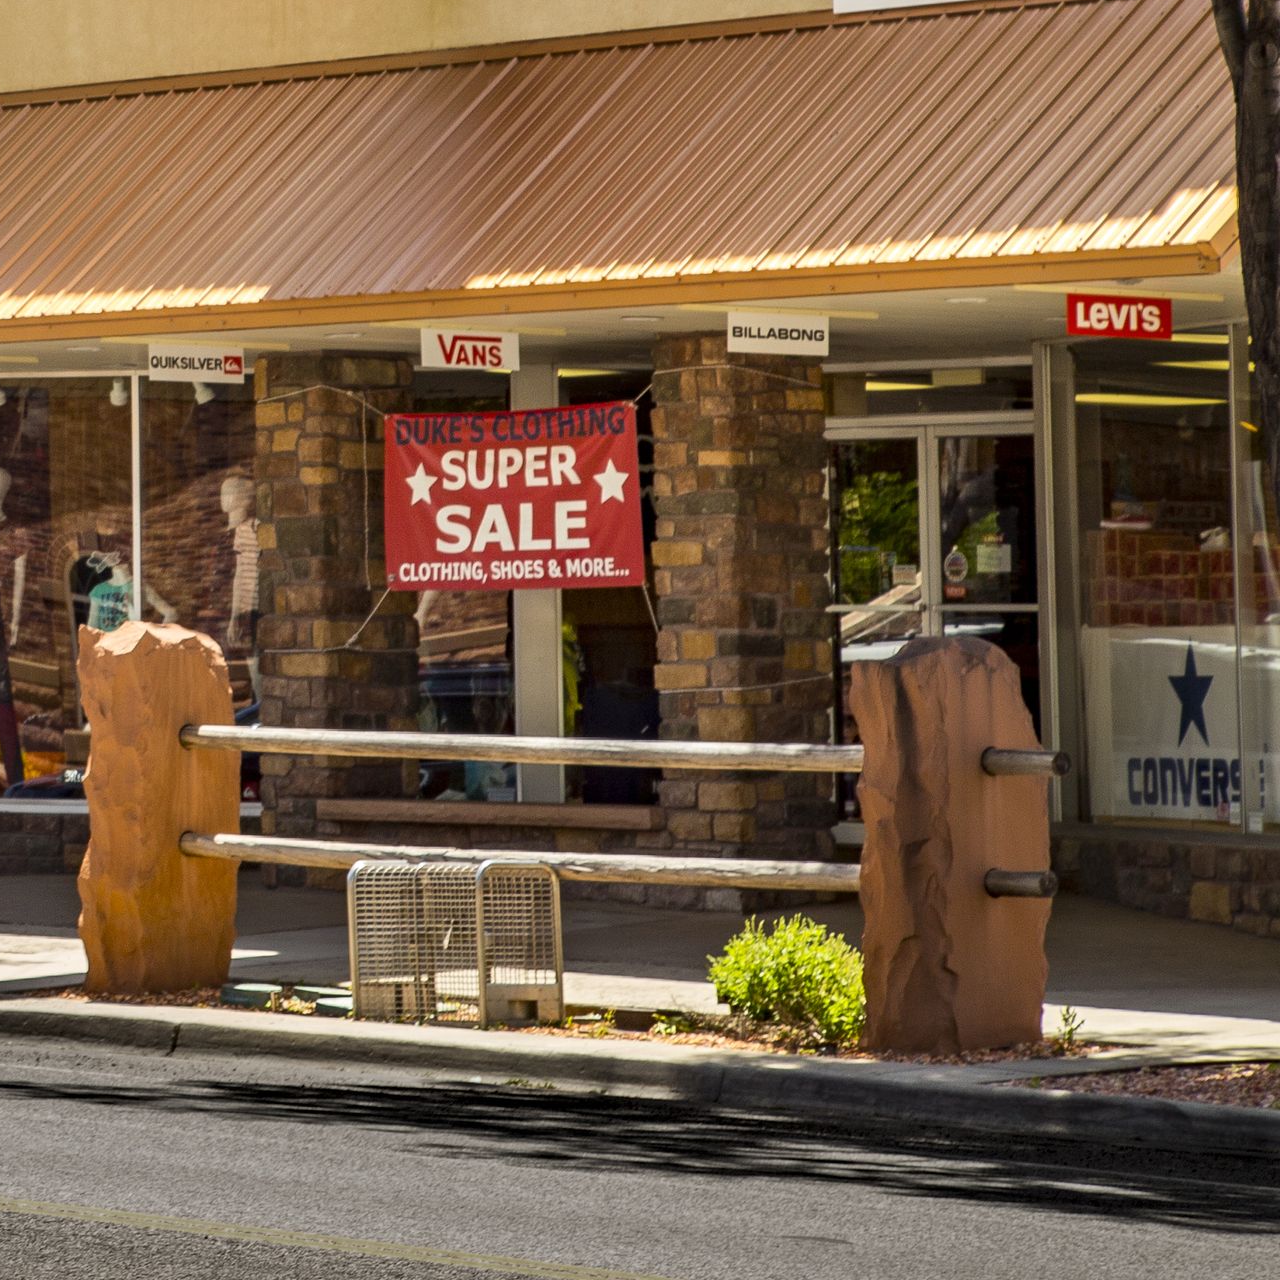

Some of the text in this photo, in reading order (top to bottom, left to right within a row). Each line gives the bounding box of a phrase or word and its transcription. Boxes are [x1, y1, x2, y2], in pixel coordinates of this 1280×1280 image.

[437, 334, 503, 367] VANS
[732, 326, 825, 342] BILLABONG
[150, 355, 223, 371] QUIKSILVER
[396, 406, 626, 446] DUKE'S CLOTHING
[441, 445, 582, 491] SUPER
[435, 500, 591, 554] SALE
[399, 557, 630, 583] CLOTHING, SHOES & MORE...
[1127, 757, 1265, 808] CONVERS
